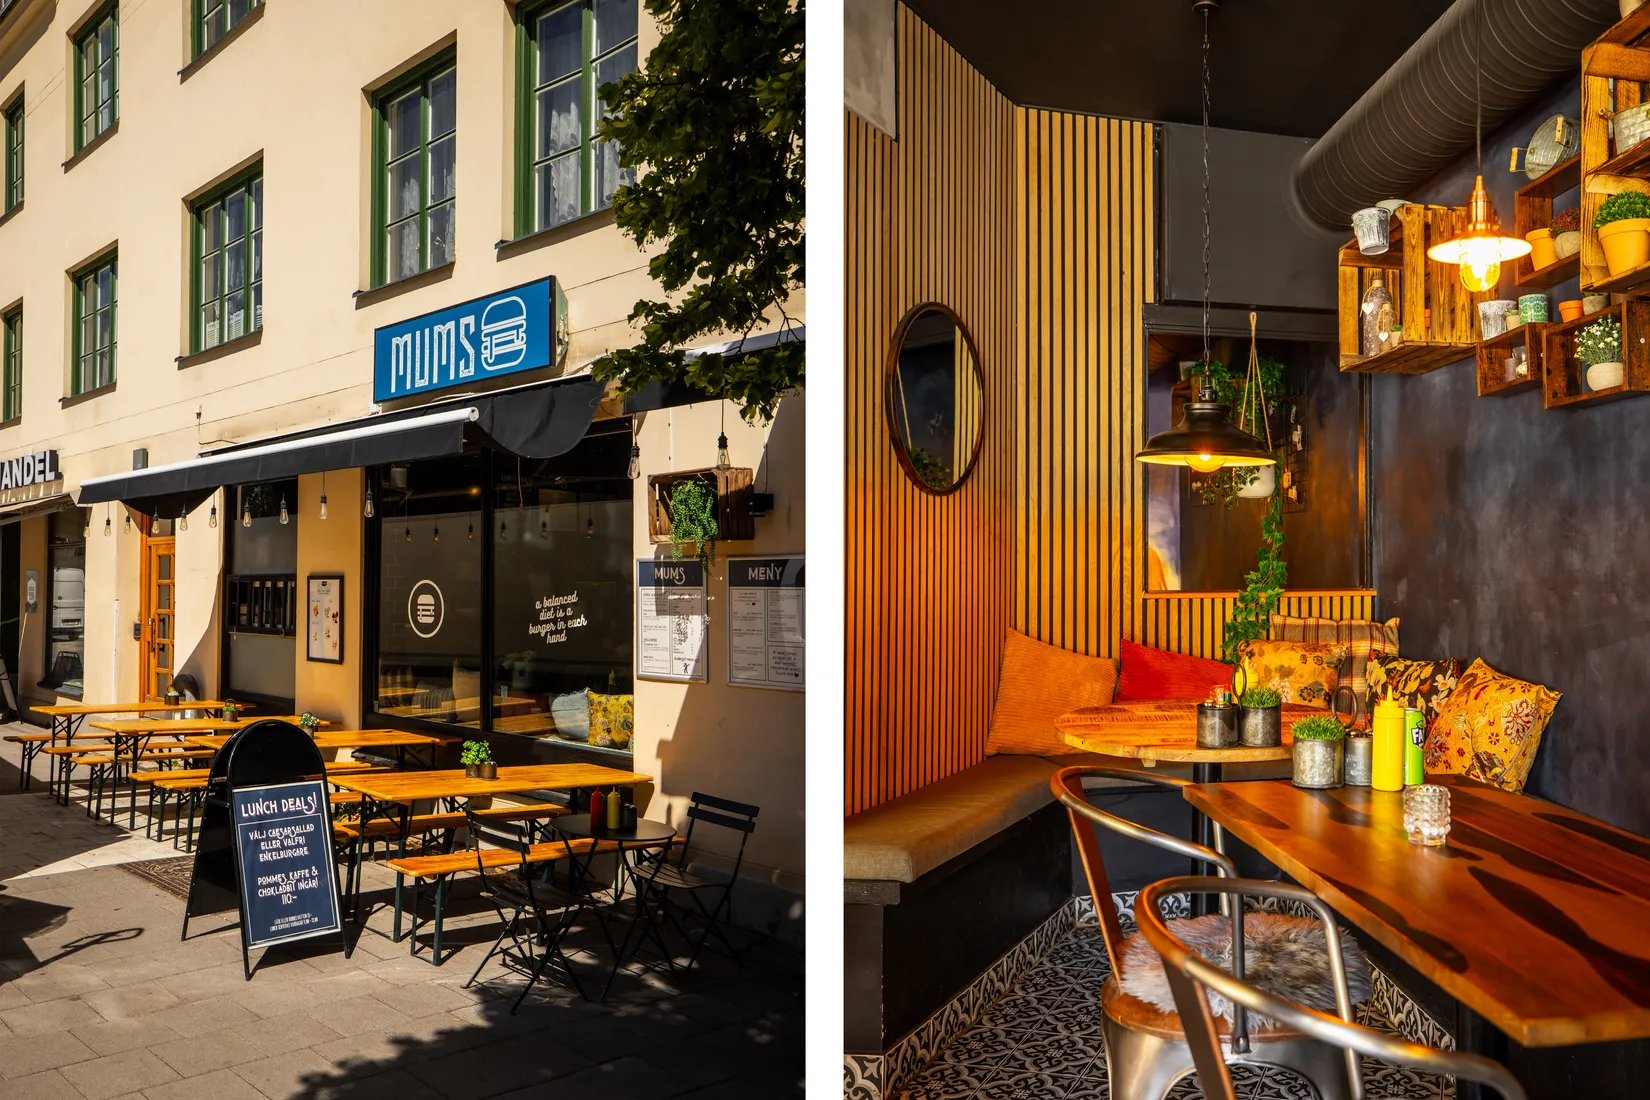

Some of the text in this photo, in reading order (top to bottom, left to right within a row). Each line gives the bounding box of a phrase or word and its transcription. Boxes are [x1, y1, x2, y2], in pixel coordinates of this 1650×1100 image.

[391, 315, 475, 393] MUMS
[0, 450, 55, 490] ANDEL
[654, 567, 686, 584] MUMS
[748, 562, 782, 580] MENY
[535, 590, 578, 609] a balanced
[540, 607, 573, 620] diet is a
[529, 614, 588, 637] burger in each
[546, 630, 567, 644] hand
[241, 792, 317, 818] LUNCH DEALS!
[248, 824, 314, 840] VÄLJ CAESARSALLAD
[260, 836, 306, 850] ELLER VALFRI
[289, 868, 310, 880] KAFFE
[312, 866, 318, 876] &
[258, 880, 296, 897] CHOKLADBIT
